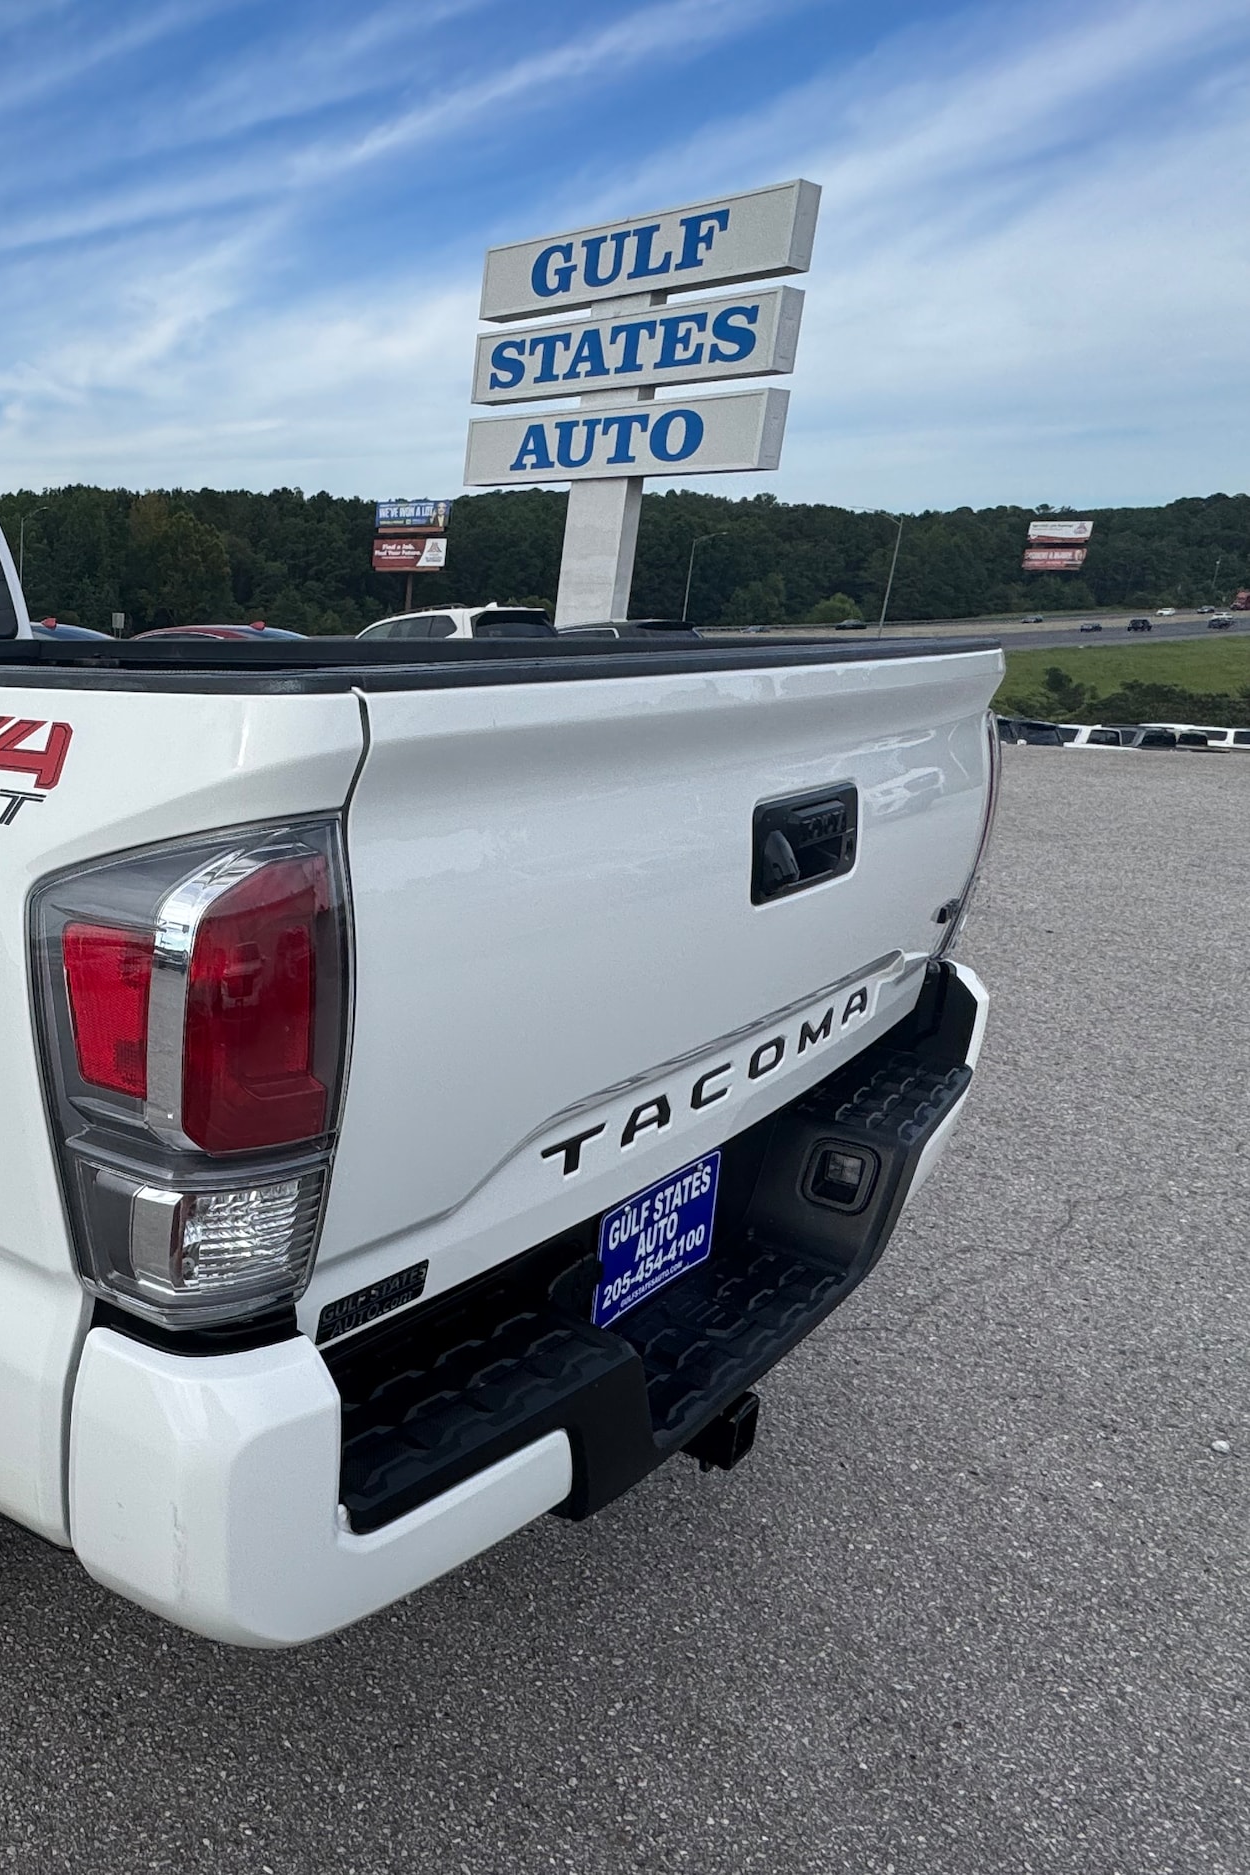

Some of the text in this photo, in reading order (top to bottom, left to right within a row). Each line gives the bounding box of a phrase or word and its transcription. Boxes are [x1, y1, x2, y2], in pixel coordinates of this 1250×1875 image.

[531, 208, 730, 298] GULF
[489, 305, 760, 390] STATES
[510, 409, 704, 471] AUTO
[540, 986, 868, 1176] TACOMA
[608, 1165, 712, 1251] GULF STATES
[634, 1212, 678, 1262] AUTO
[322, 1266, 427, 1323] GULF STATES
[602, 1224, 706, 1310] 205-454-4100
[329, 1290, 414, 1338] AUTO.com
